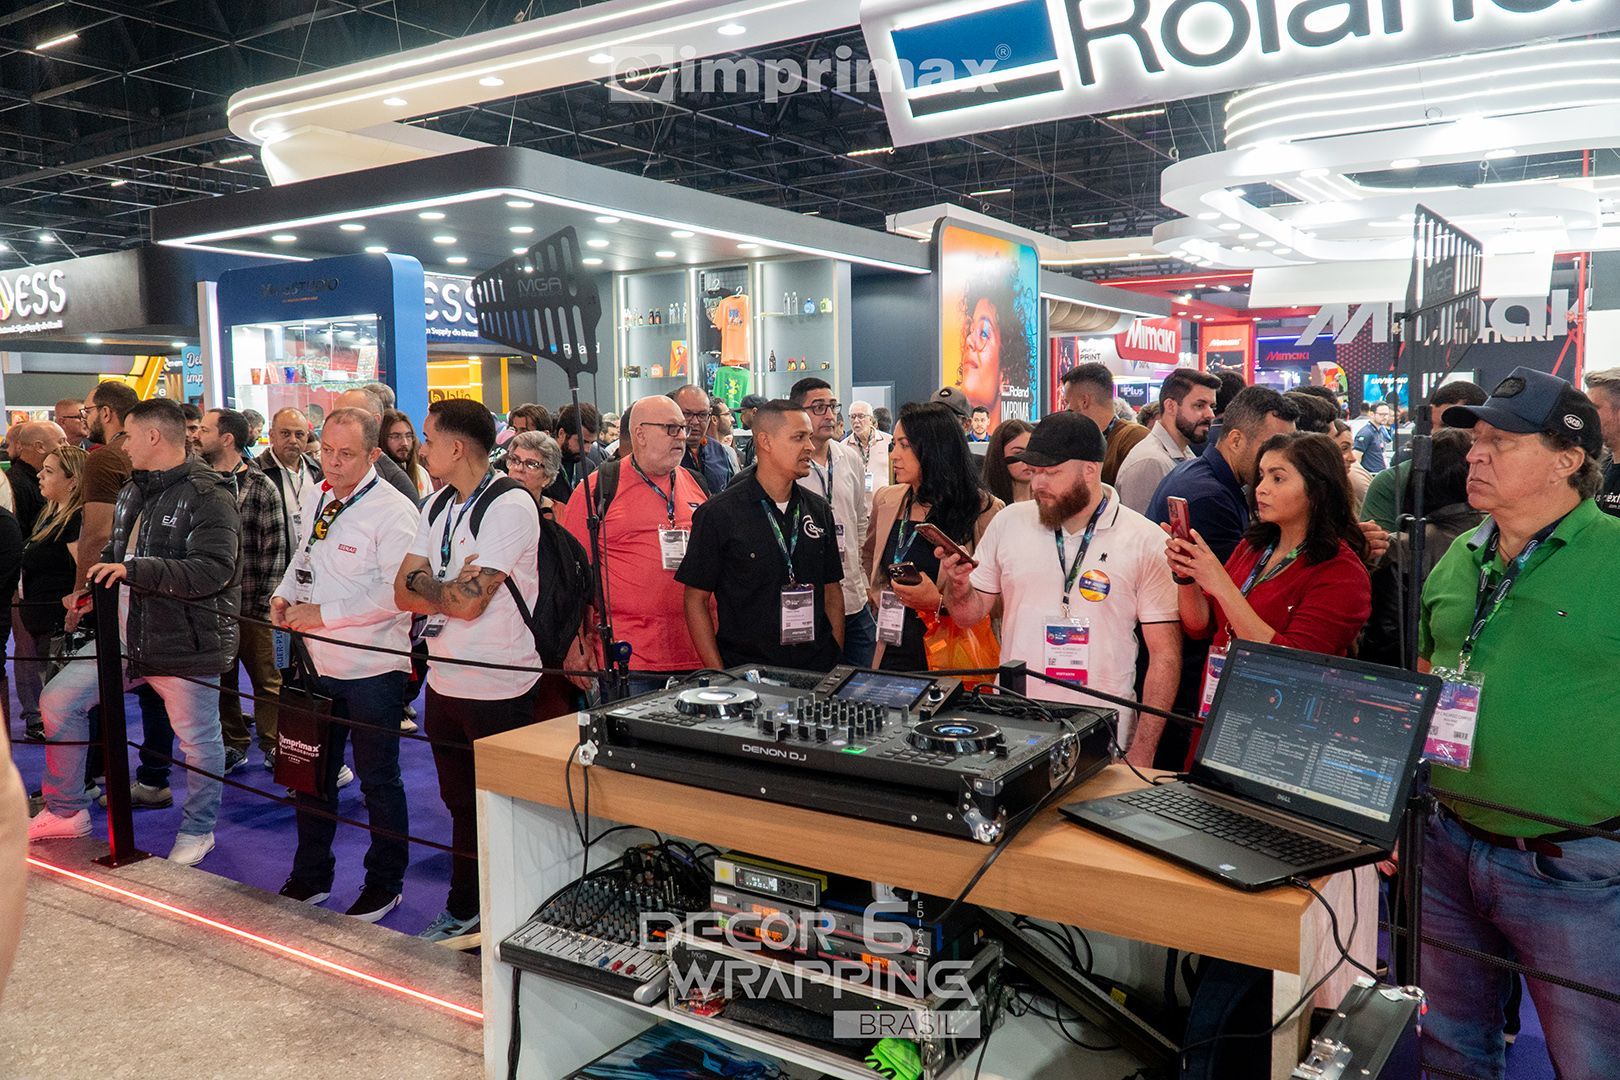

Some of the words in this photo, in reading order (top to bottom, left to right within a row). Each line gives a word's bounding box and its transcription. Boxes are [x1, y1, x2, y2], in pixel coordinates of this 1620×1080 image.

[1067, 0, 1584, 86] Rola
[517, 277, 562, 292] MGA
[742, 744, 787, 758] DENON
[789, 751, 807, 762] DJ
